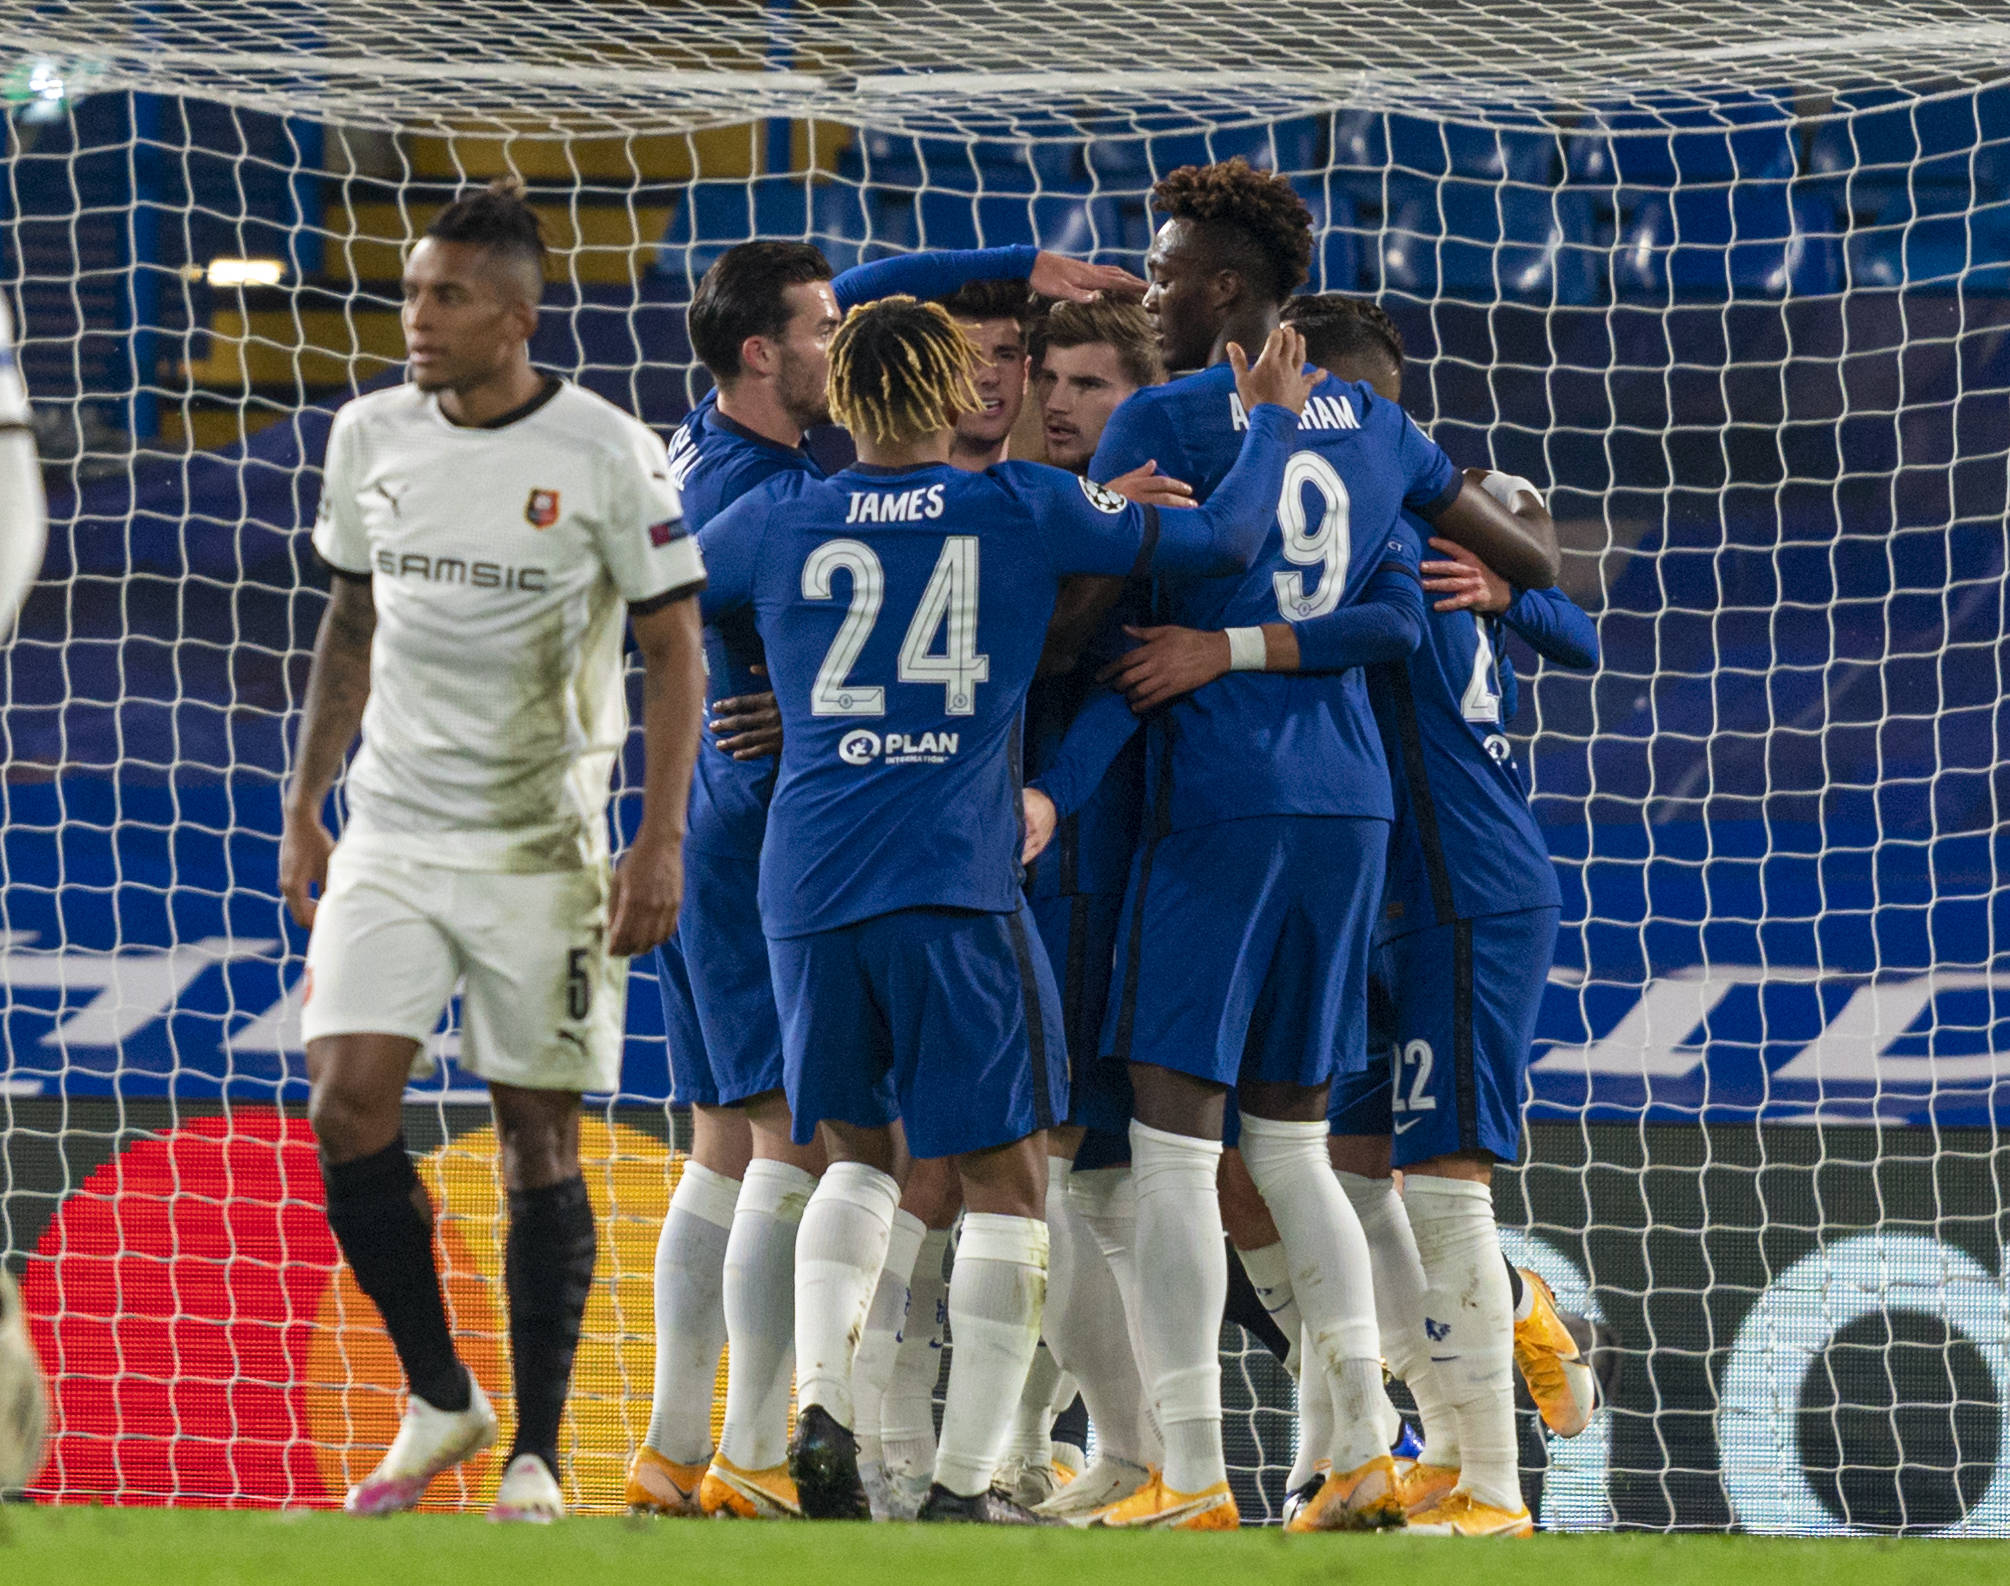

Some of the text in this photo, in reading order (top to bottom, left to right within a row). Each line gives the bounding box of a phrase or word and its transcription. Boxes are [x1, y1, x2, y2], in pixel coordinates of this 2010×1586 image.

[1229, 392, 1361, 431] AHAM
[845, 484, 945, 524] JAMES
[1273, 450, 1350, 622] 9
[377, 550, 547, 592] SAMSIC
[801, 535, 989, 716] 24
[885, 732, 959, 754] PLAN
[566, 946, 590, 1021] 5
